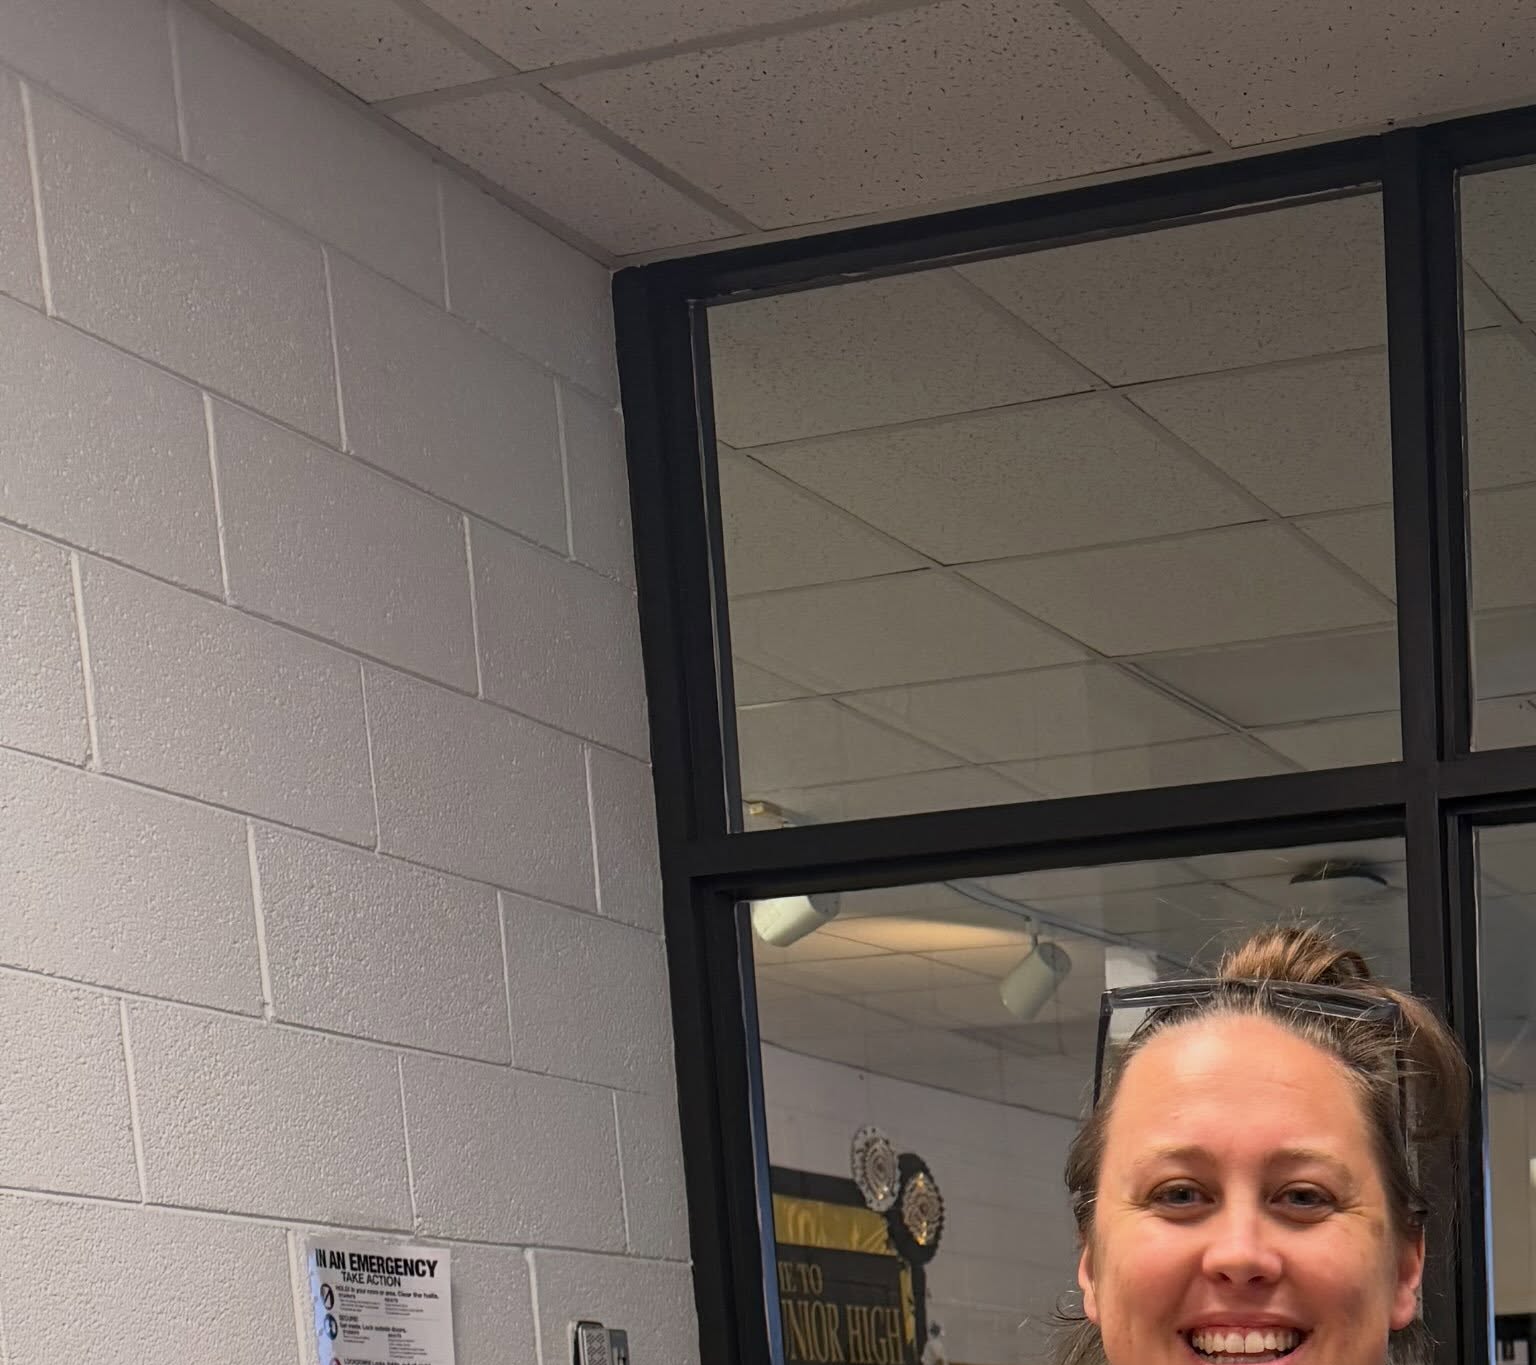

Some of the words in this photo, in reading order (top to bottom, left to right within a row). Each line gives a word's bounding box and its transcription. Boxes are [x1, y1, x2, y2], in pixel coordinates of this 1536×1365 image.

[315, 1248, 327, 1268] IN
[329, 1250, 346, 1271] AN
[348, 1253, 438, 1278] EMERGENCY
[341, 1271, 365, 1284] TAKE
[366, 1274, 401, 1287] ACTION
[800, 1263, 823, 1294] TO
[847, 1303, 905, 1365] HIGH
